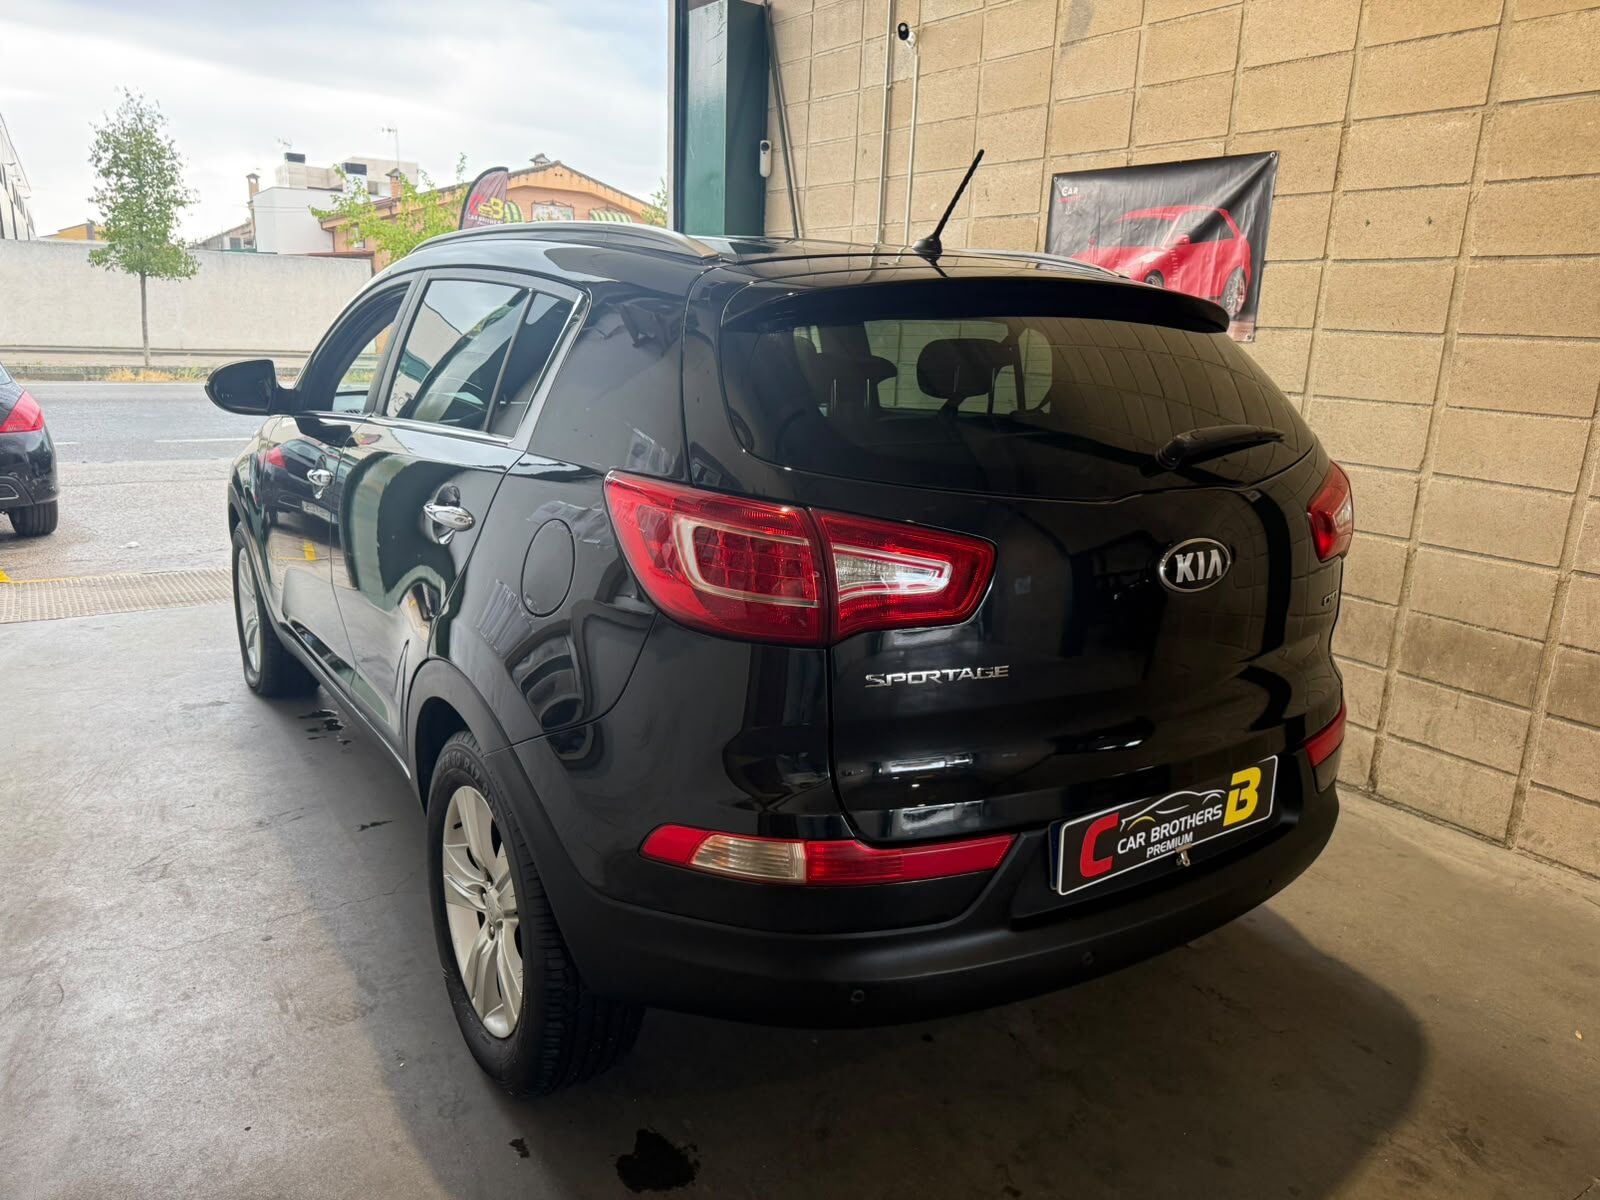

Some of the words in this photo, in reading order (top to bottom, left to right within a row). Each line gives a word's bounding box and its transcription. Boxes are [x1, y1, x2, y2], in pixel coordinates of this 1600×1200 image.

[1061, 186, 1079, 197] CAR
[1175, 549, 1223, 584] KIA
[865, 665, 1010, 689] SPORTAGE
[1223, 766, 1262, 827] B
[1079, 812, 1120, 878] C
[1117, 832, 1146, 854] CAR
[1150, 803, 1223, 843] BROTHERS
[1146, 831, 1194, 859] PREMIUM
